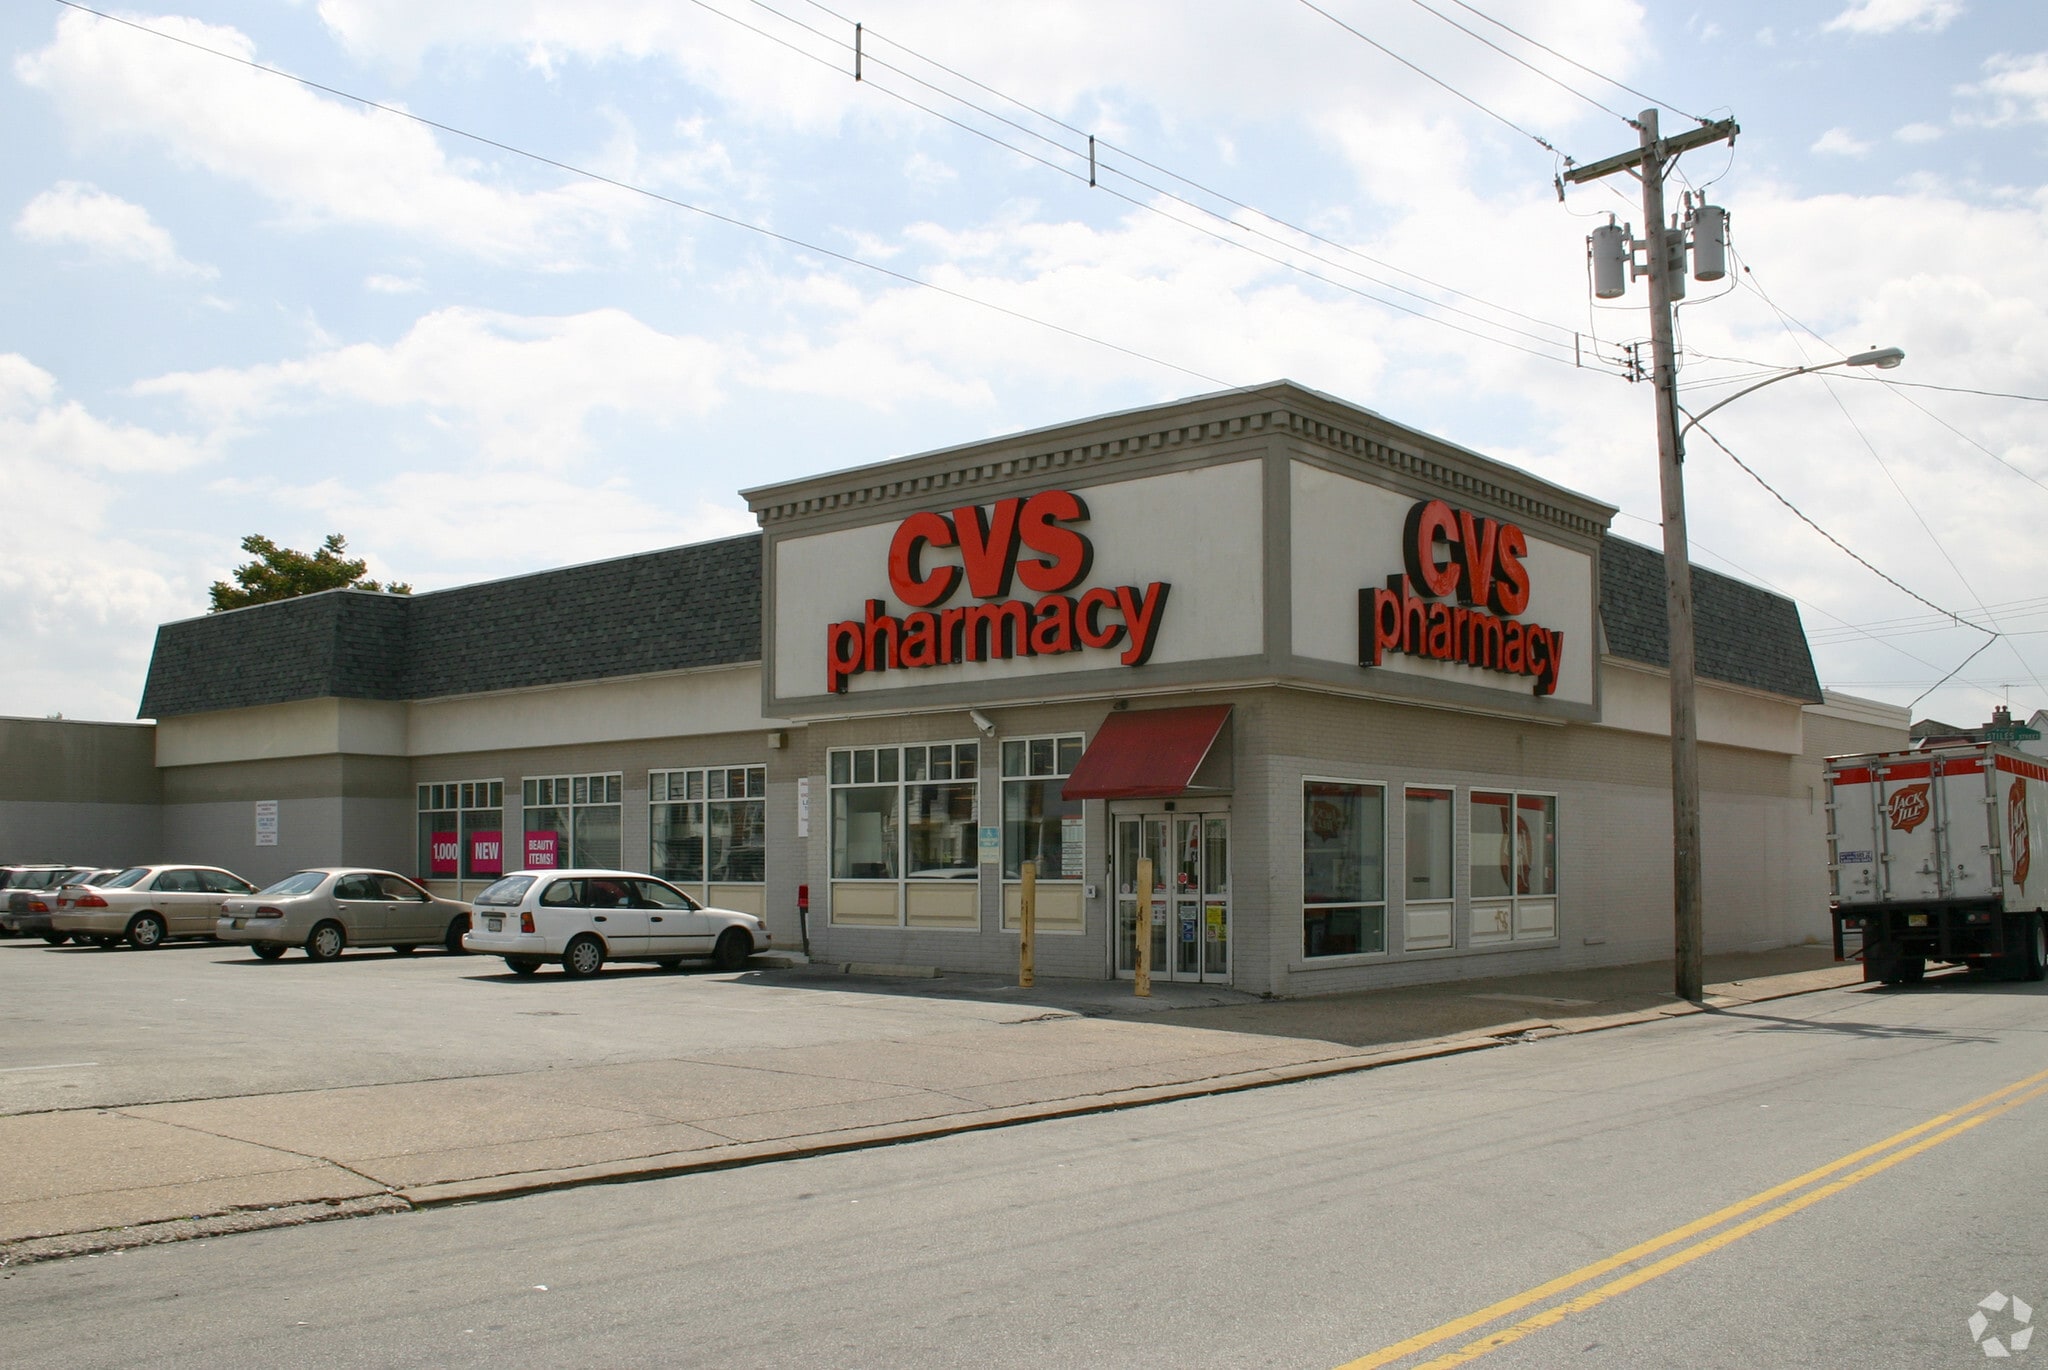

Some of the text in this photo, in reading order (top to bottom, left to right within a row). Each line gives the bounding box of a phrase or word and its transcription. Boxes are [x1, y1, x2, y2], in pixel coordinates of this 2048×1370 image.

[888, 489, 1094, 608] CVS
[1403, 499, 1530, 616] CVS
[827, 582, 1171, 694] pharmacy
[1359, 573, 1563, 696] pharmacy
[1986, 732, 2015, 740] STILES
[1889, 791, 1924, 817] JACK
[1894, 805, 1921, 827] JILL
[433, 843, 458, 862] 1,000
[475, 842, 499, 860] NEW
[528, 840, 554, 850] BEAUTY
[528, 853, 554, 865] ITEMS!
